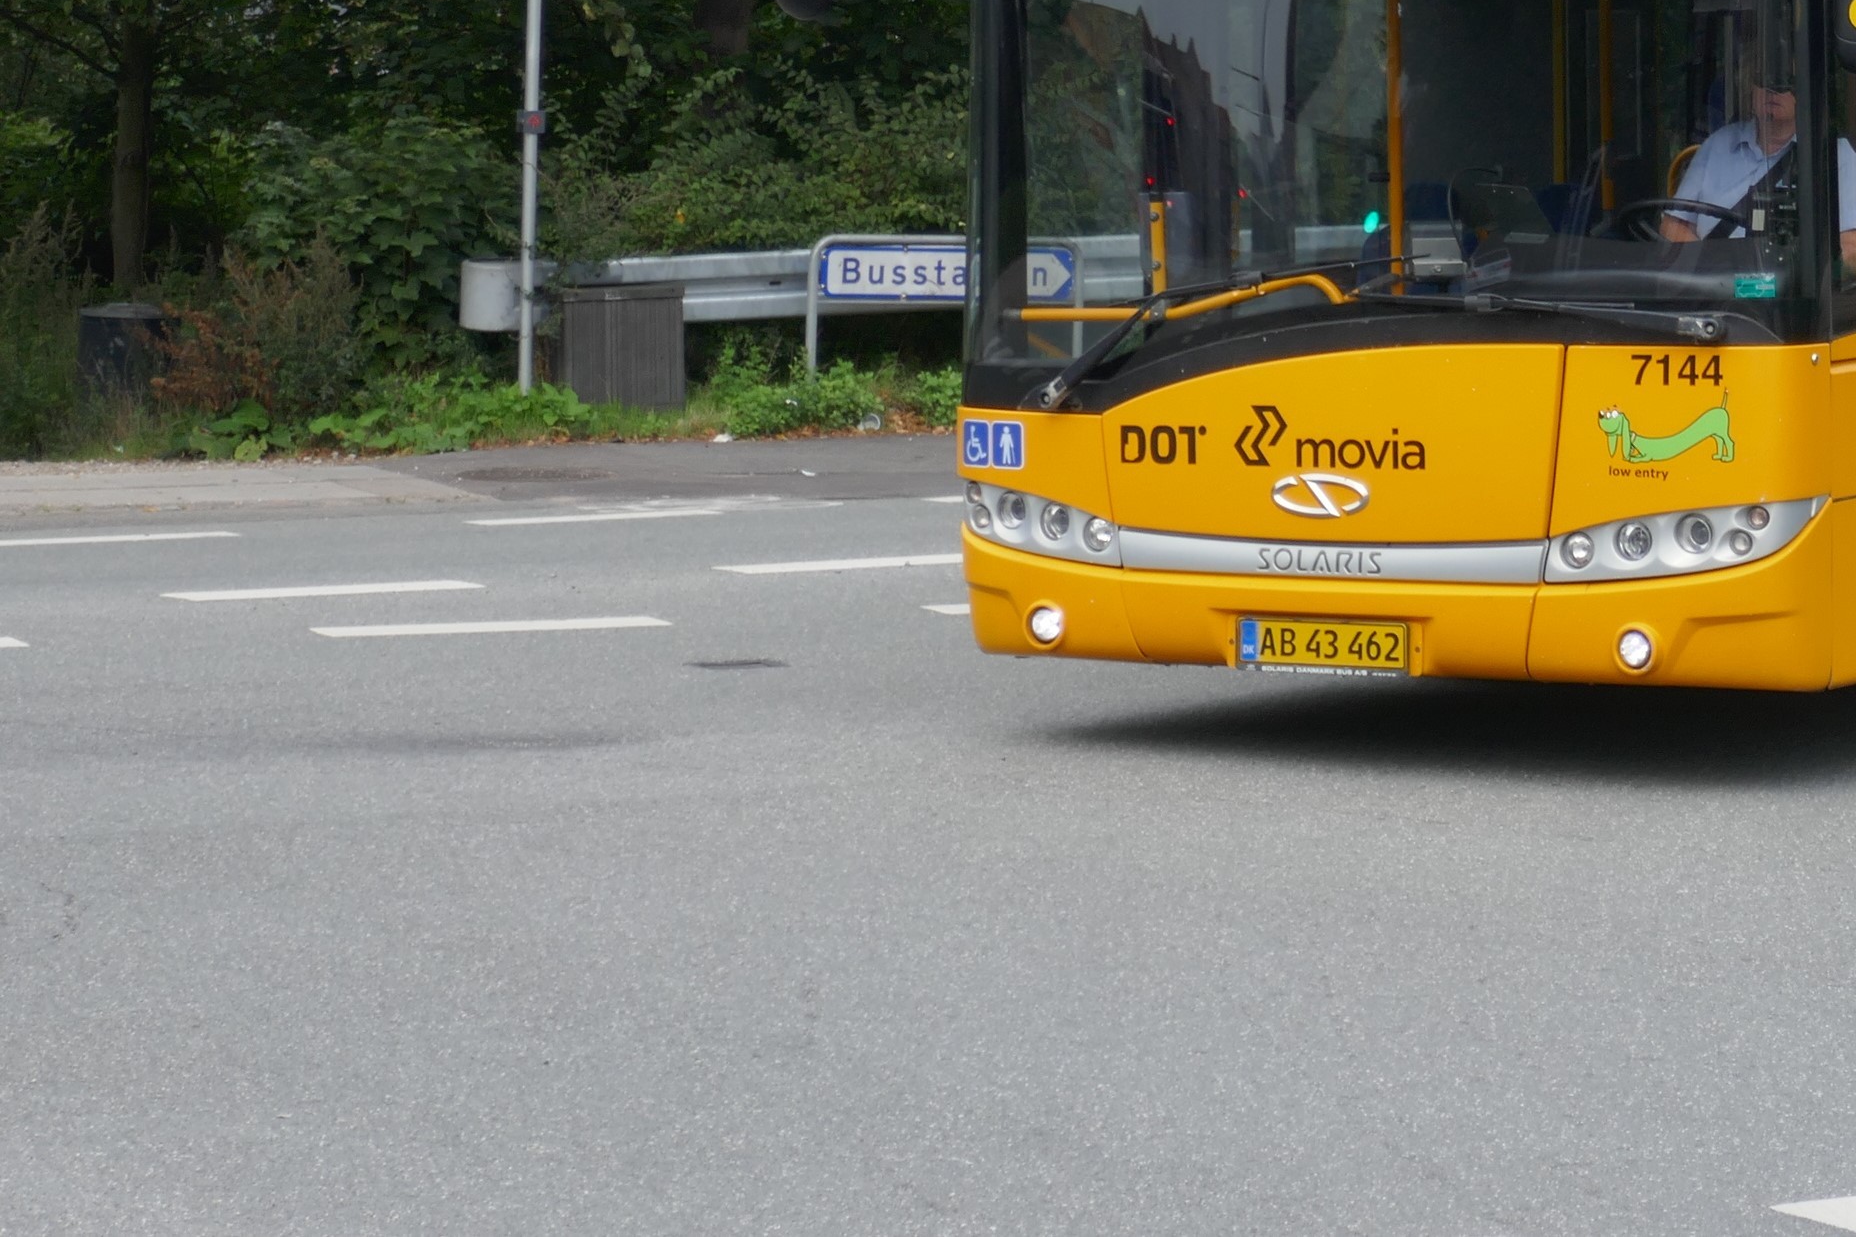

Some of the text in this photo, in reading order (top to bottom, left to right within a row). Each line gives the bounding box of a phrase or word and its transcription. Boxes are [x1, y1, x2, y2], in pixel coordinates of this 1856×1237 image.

[841, 257, 1048, 287] Busstan
[1631, 354, 1723, 386] 7144
[1120, 425, 1207, 464] DOT
[1295, 428, 1426, 470] movia
[1609, 465, 1669, 481] low entry
[1257, 548, 1382, 574] SOLARIS
[1243, 645, 1255, 655] DK
[1260, 628, 1400, 662] AB 43 462
[1261, 665, 1294, 673] SOLARIS
[1296, 667, 1335, 675] DANMARK
[1336, 668, 1353, 676] BUS
